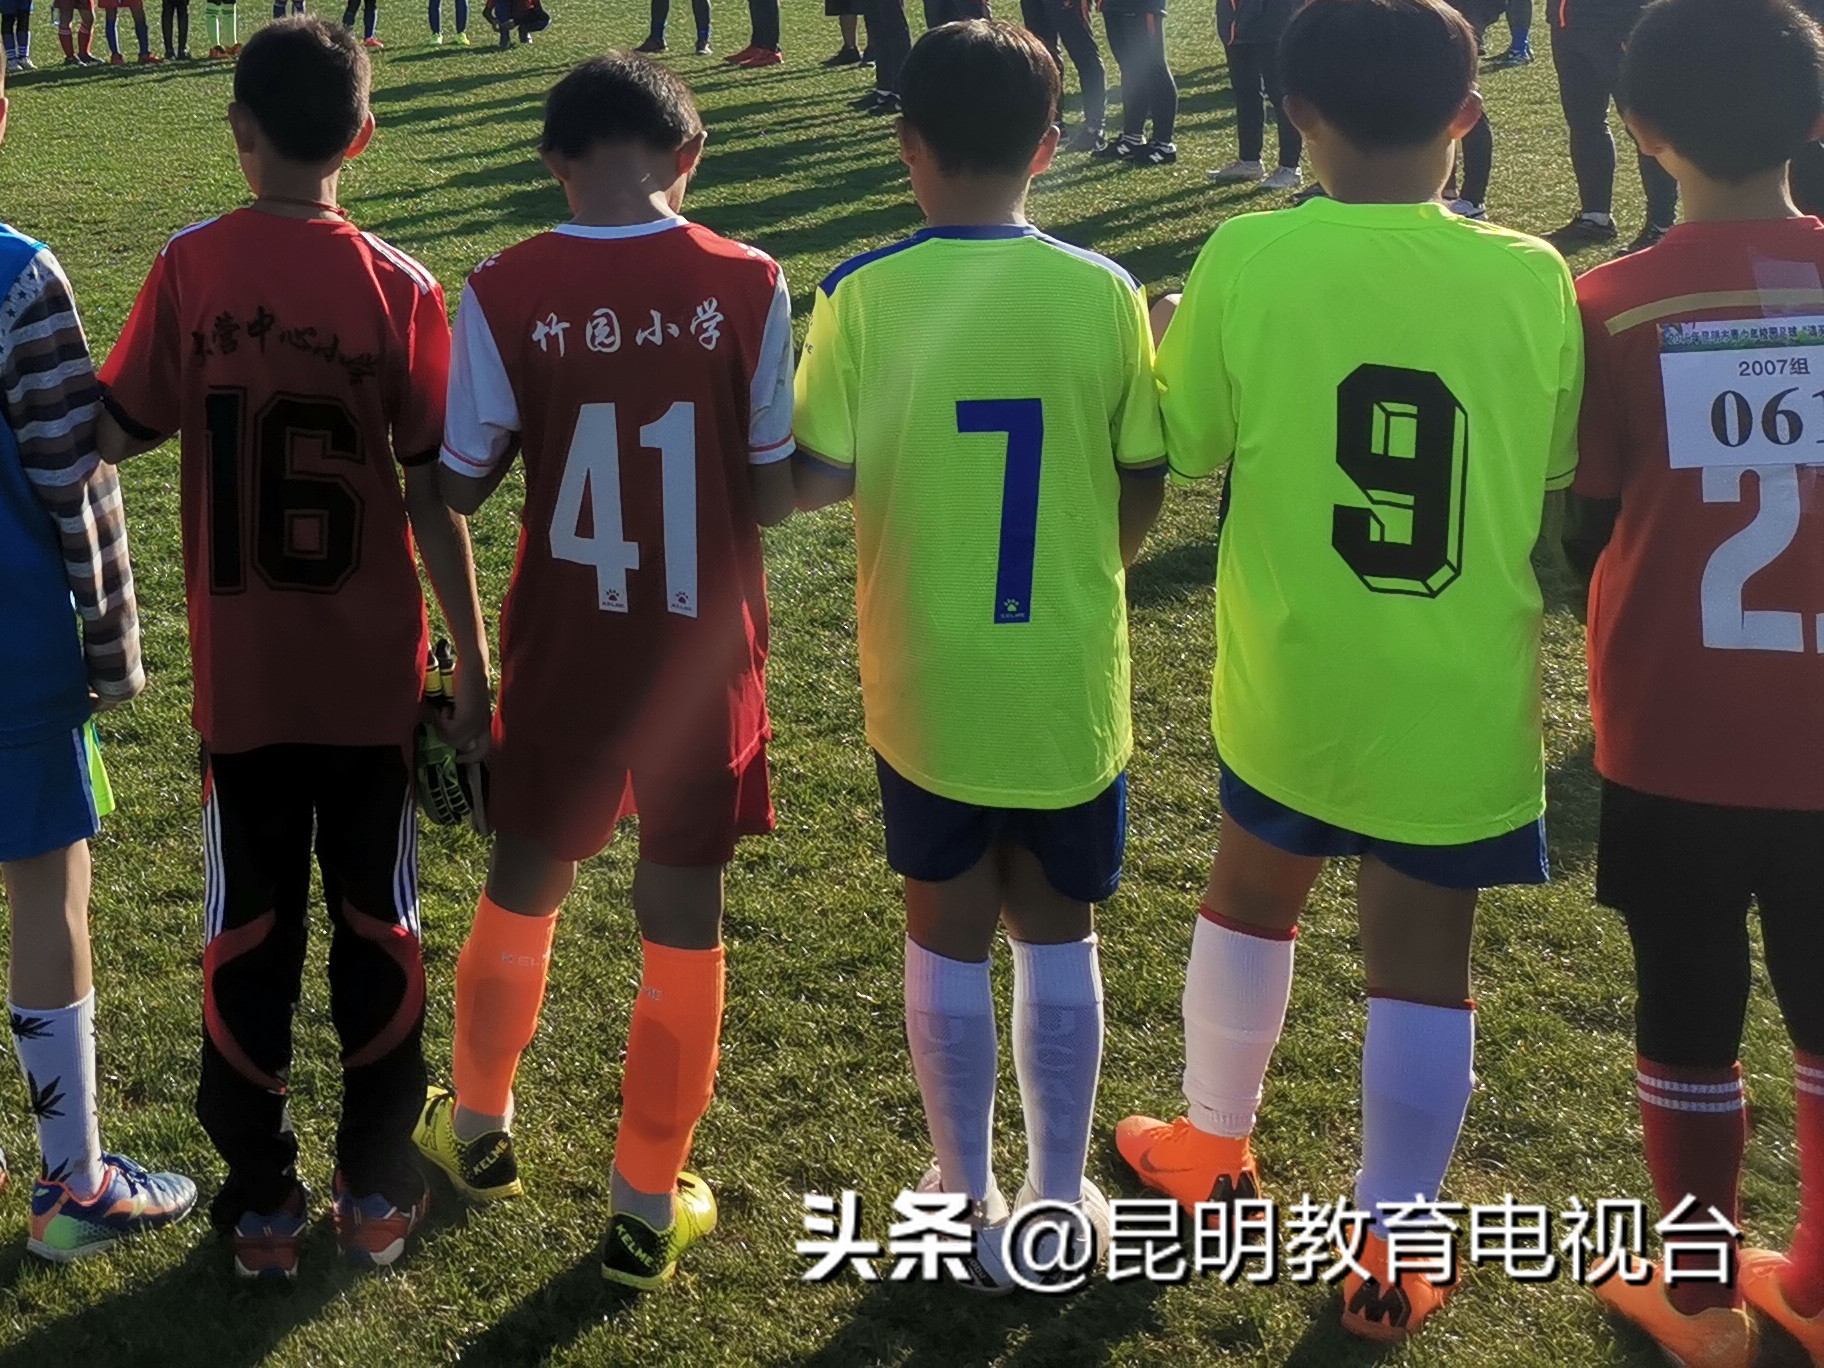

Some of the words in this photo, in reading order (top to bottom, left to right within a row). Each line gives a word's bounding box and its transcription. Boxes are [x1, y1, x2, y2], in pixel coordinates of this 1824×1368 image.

[532, 297, 724, 356] 竹园小学
[1738, 358, 1810, 376] 2007组
[206, 386, 366, 595] 16
[549, 401, 698, 618] 41
[955, 398, 1043, 623] 7
[1332, 363, 1468, 598] 9
[1699, 466, 1824, 654] 2
[473, 1138, 509, 1176] KELME
[615, 1223, 655, 1268] KELME
